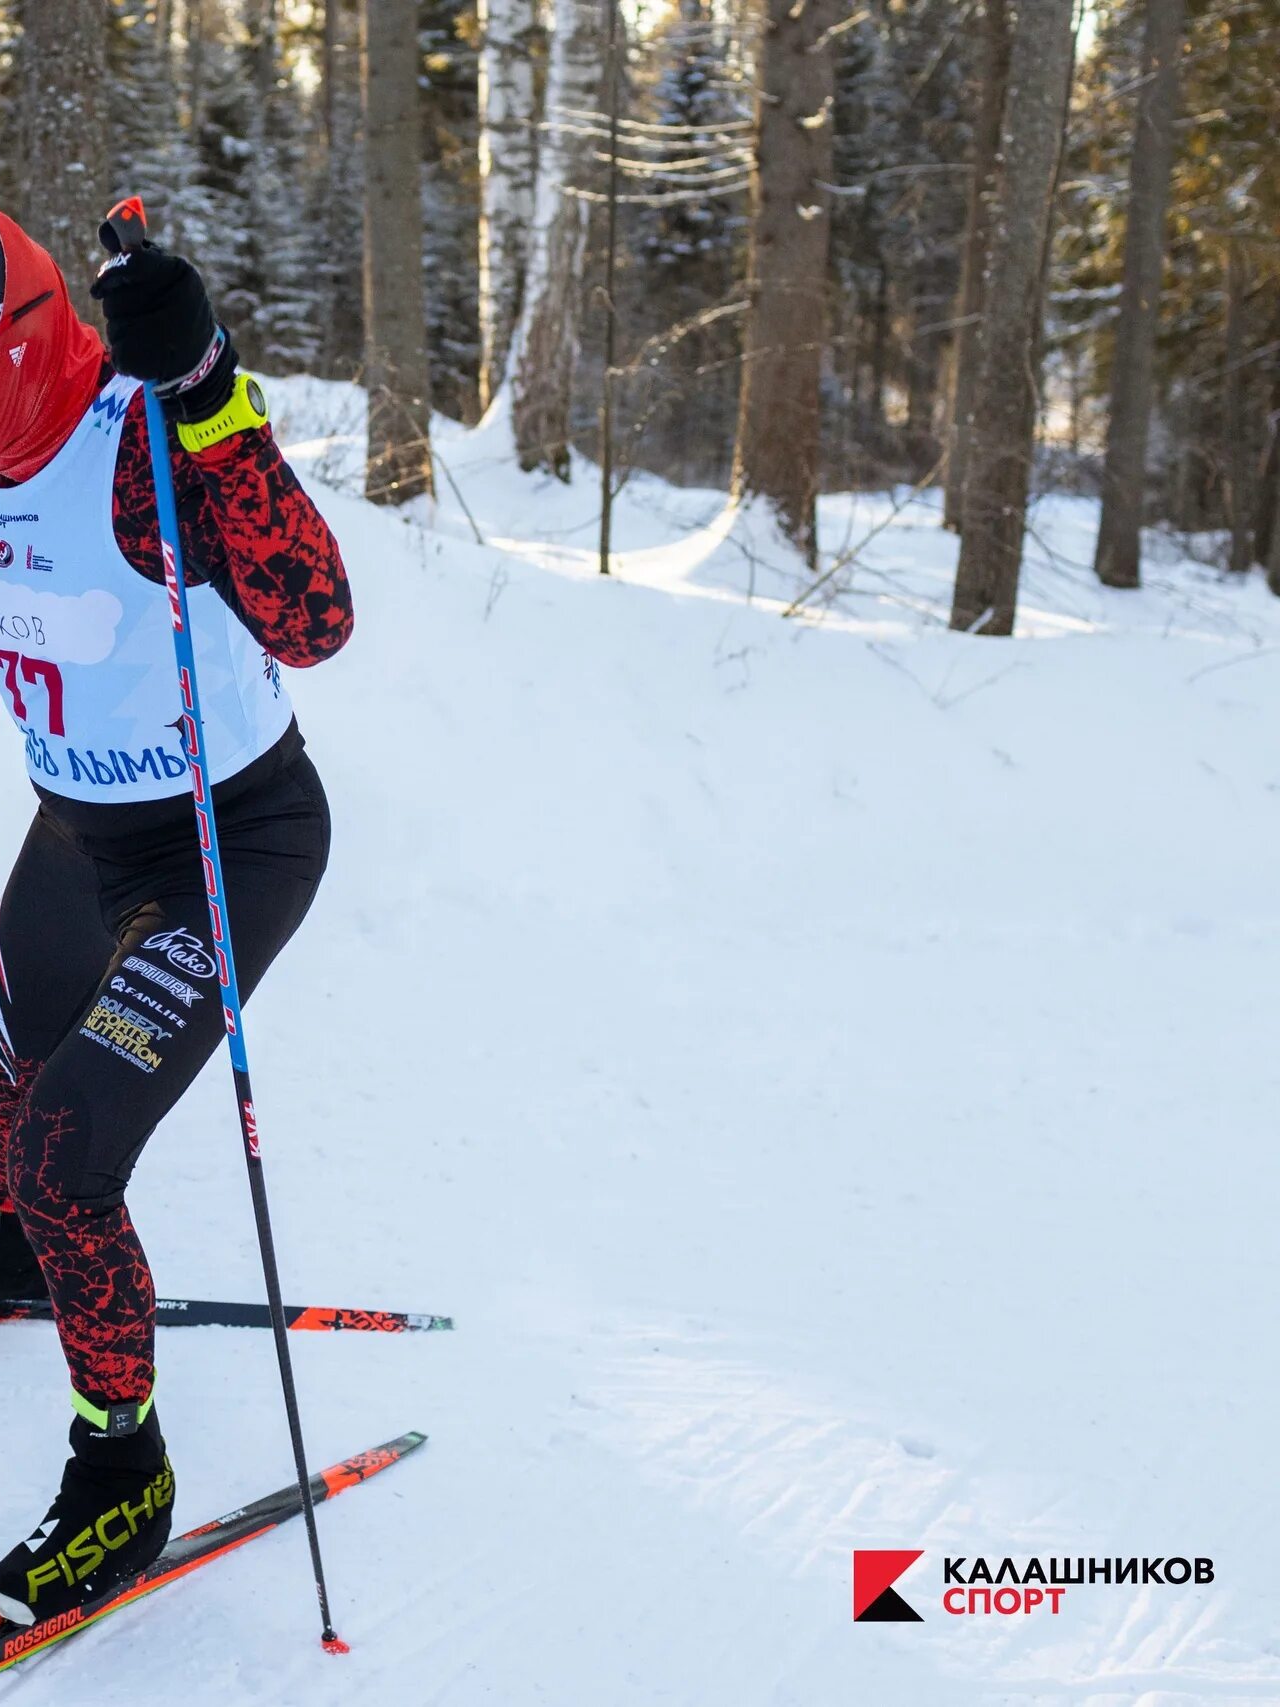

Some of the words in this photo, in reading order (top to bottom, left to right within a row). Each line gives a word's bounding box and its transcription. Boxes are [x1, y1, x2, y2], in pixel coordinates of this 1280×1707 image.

[122, 956, 205, 1008] OPTIWAX
[91, 1005, 151, 1045] SPORTS
[97, 995, 169, 1041] SQUEEZY
[125, 987, 187, 1029] FANLIFE
[83, 1015, 163, 1068] NUTRITION
[111, 1043, 156, 1074] YOURSELF
[3, 1606, 86, 1660] ROSSIGNOL
